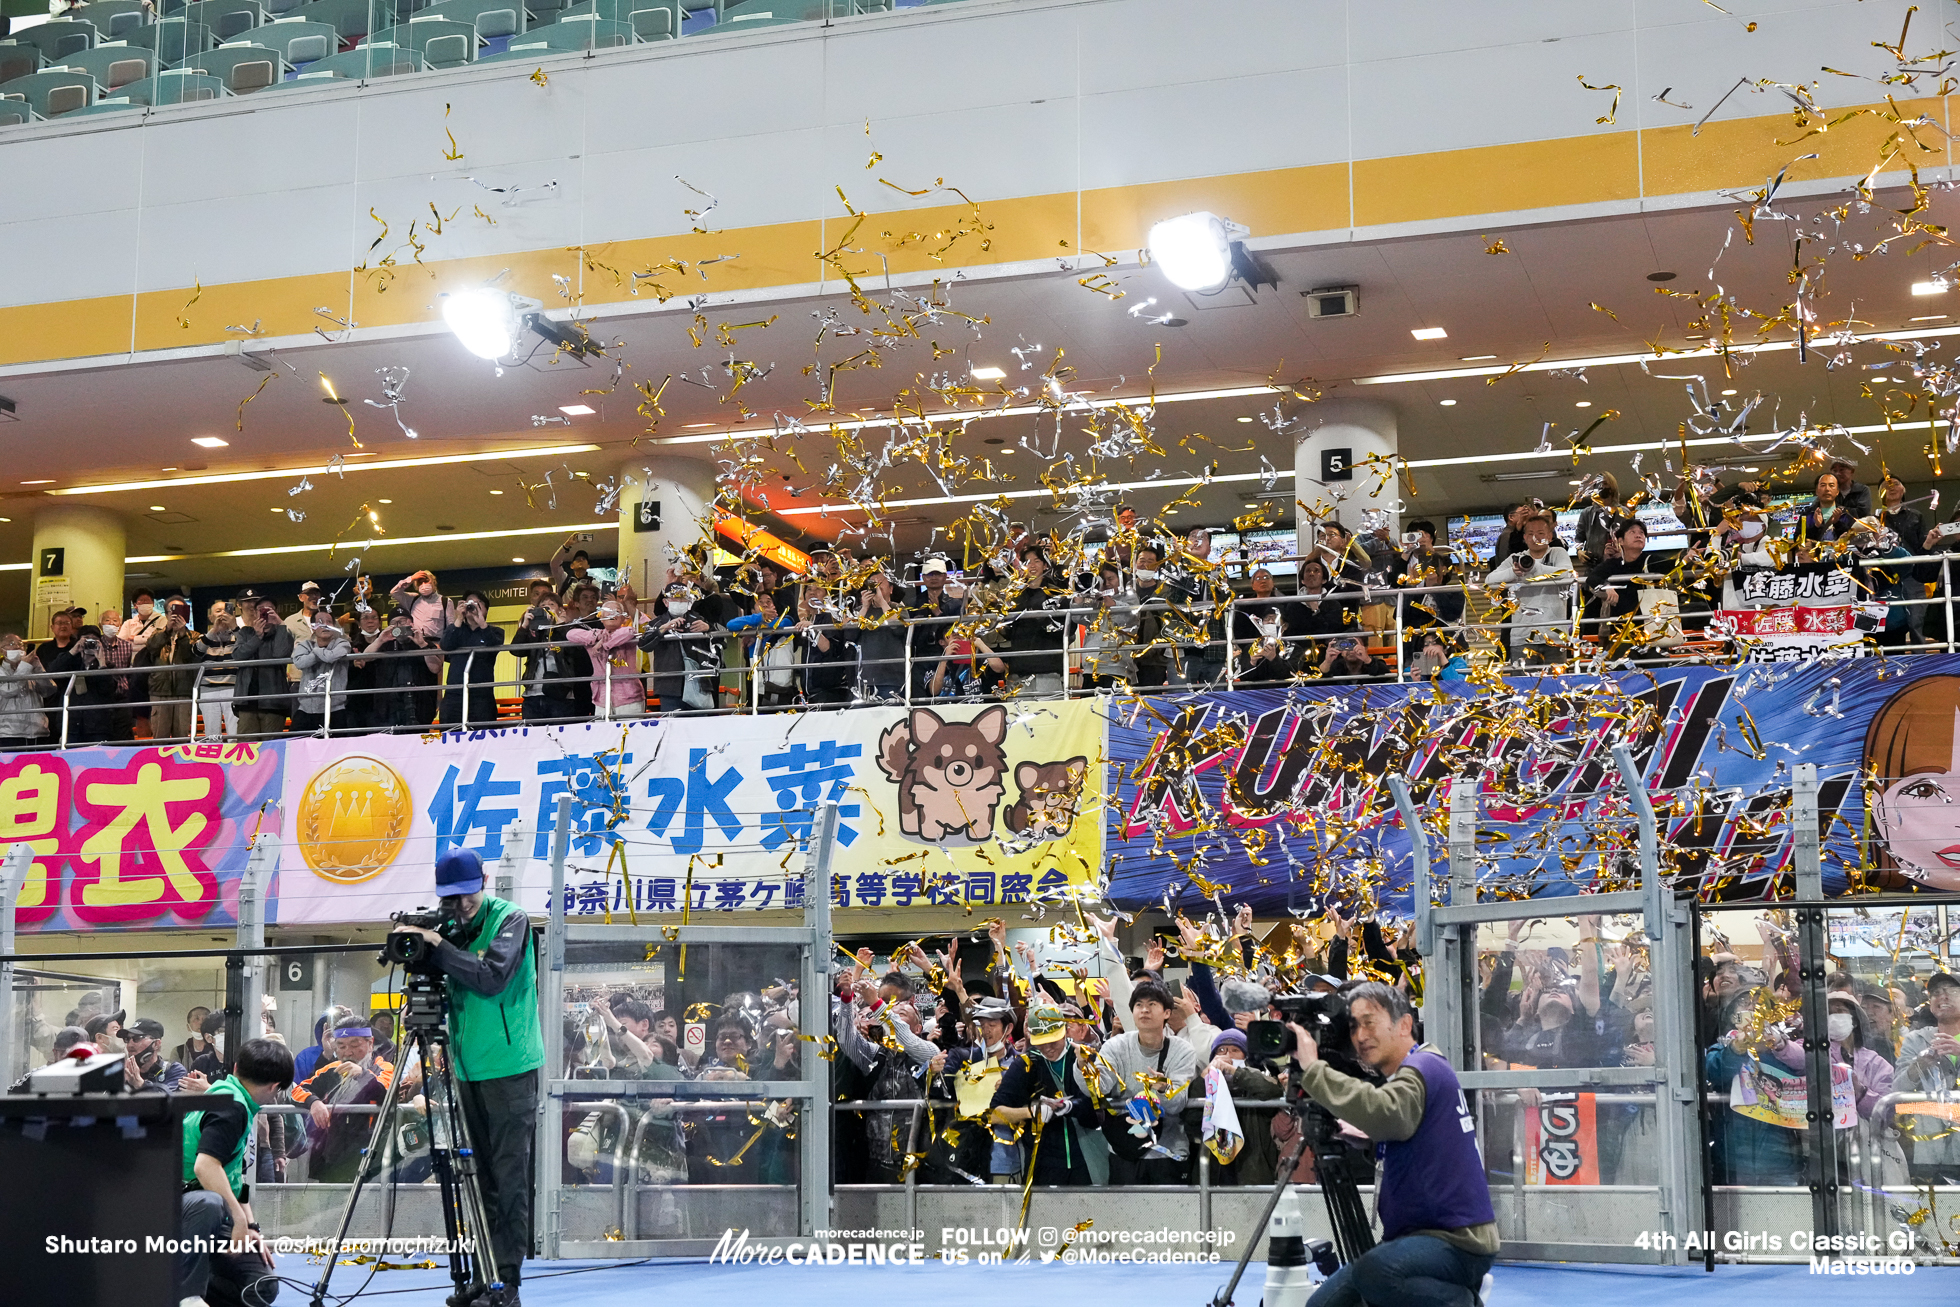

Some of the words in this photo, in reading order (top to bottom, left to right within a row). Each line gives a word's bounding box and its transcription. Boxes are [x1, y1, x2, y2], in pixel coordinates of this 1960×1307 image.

[1329, 455, 1343, 473] 5
[46, 554, 57, 569] 7
[1743, 567, 1853, 600] 佐藤水菜
[1754, 611, 1796, 634] 佐藤
[1804, 609, 1848, 632] 水菜
[427, 739, 863, 868] 佐藤水菜
[288, 961, 302, 982] 6
